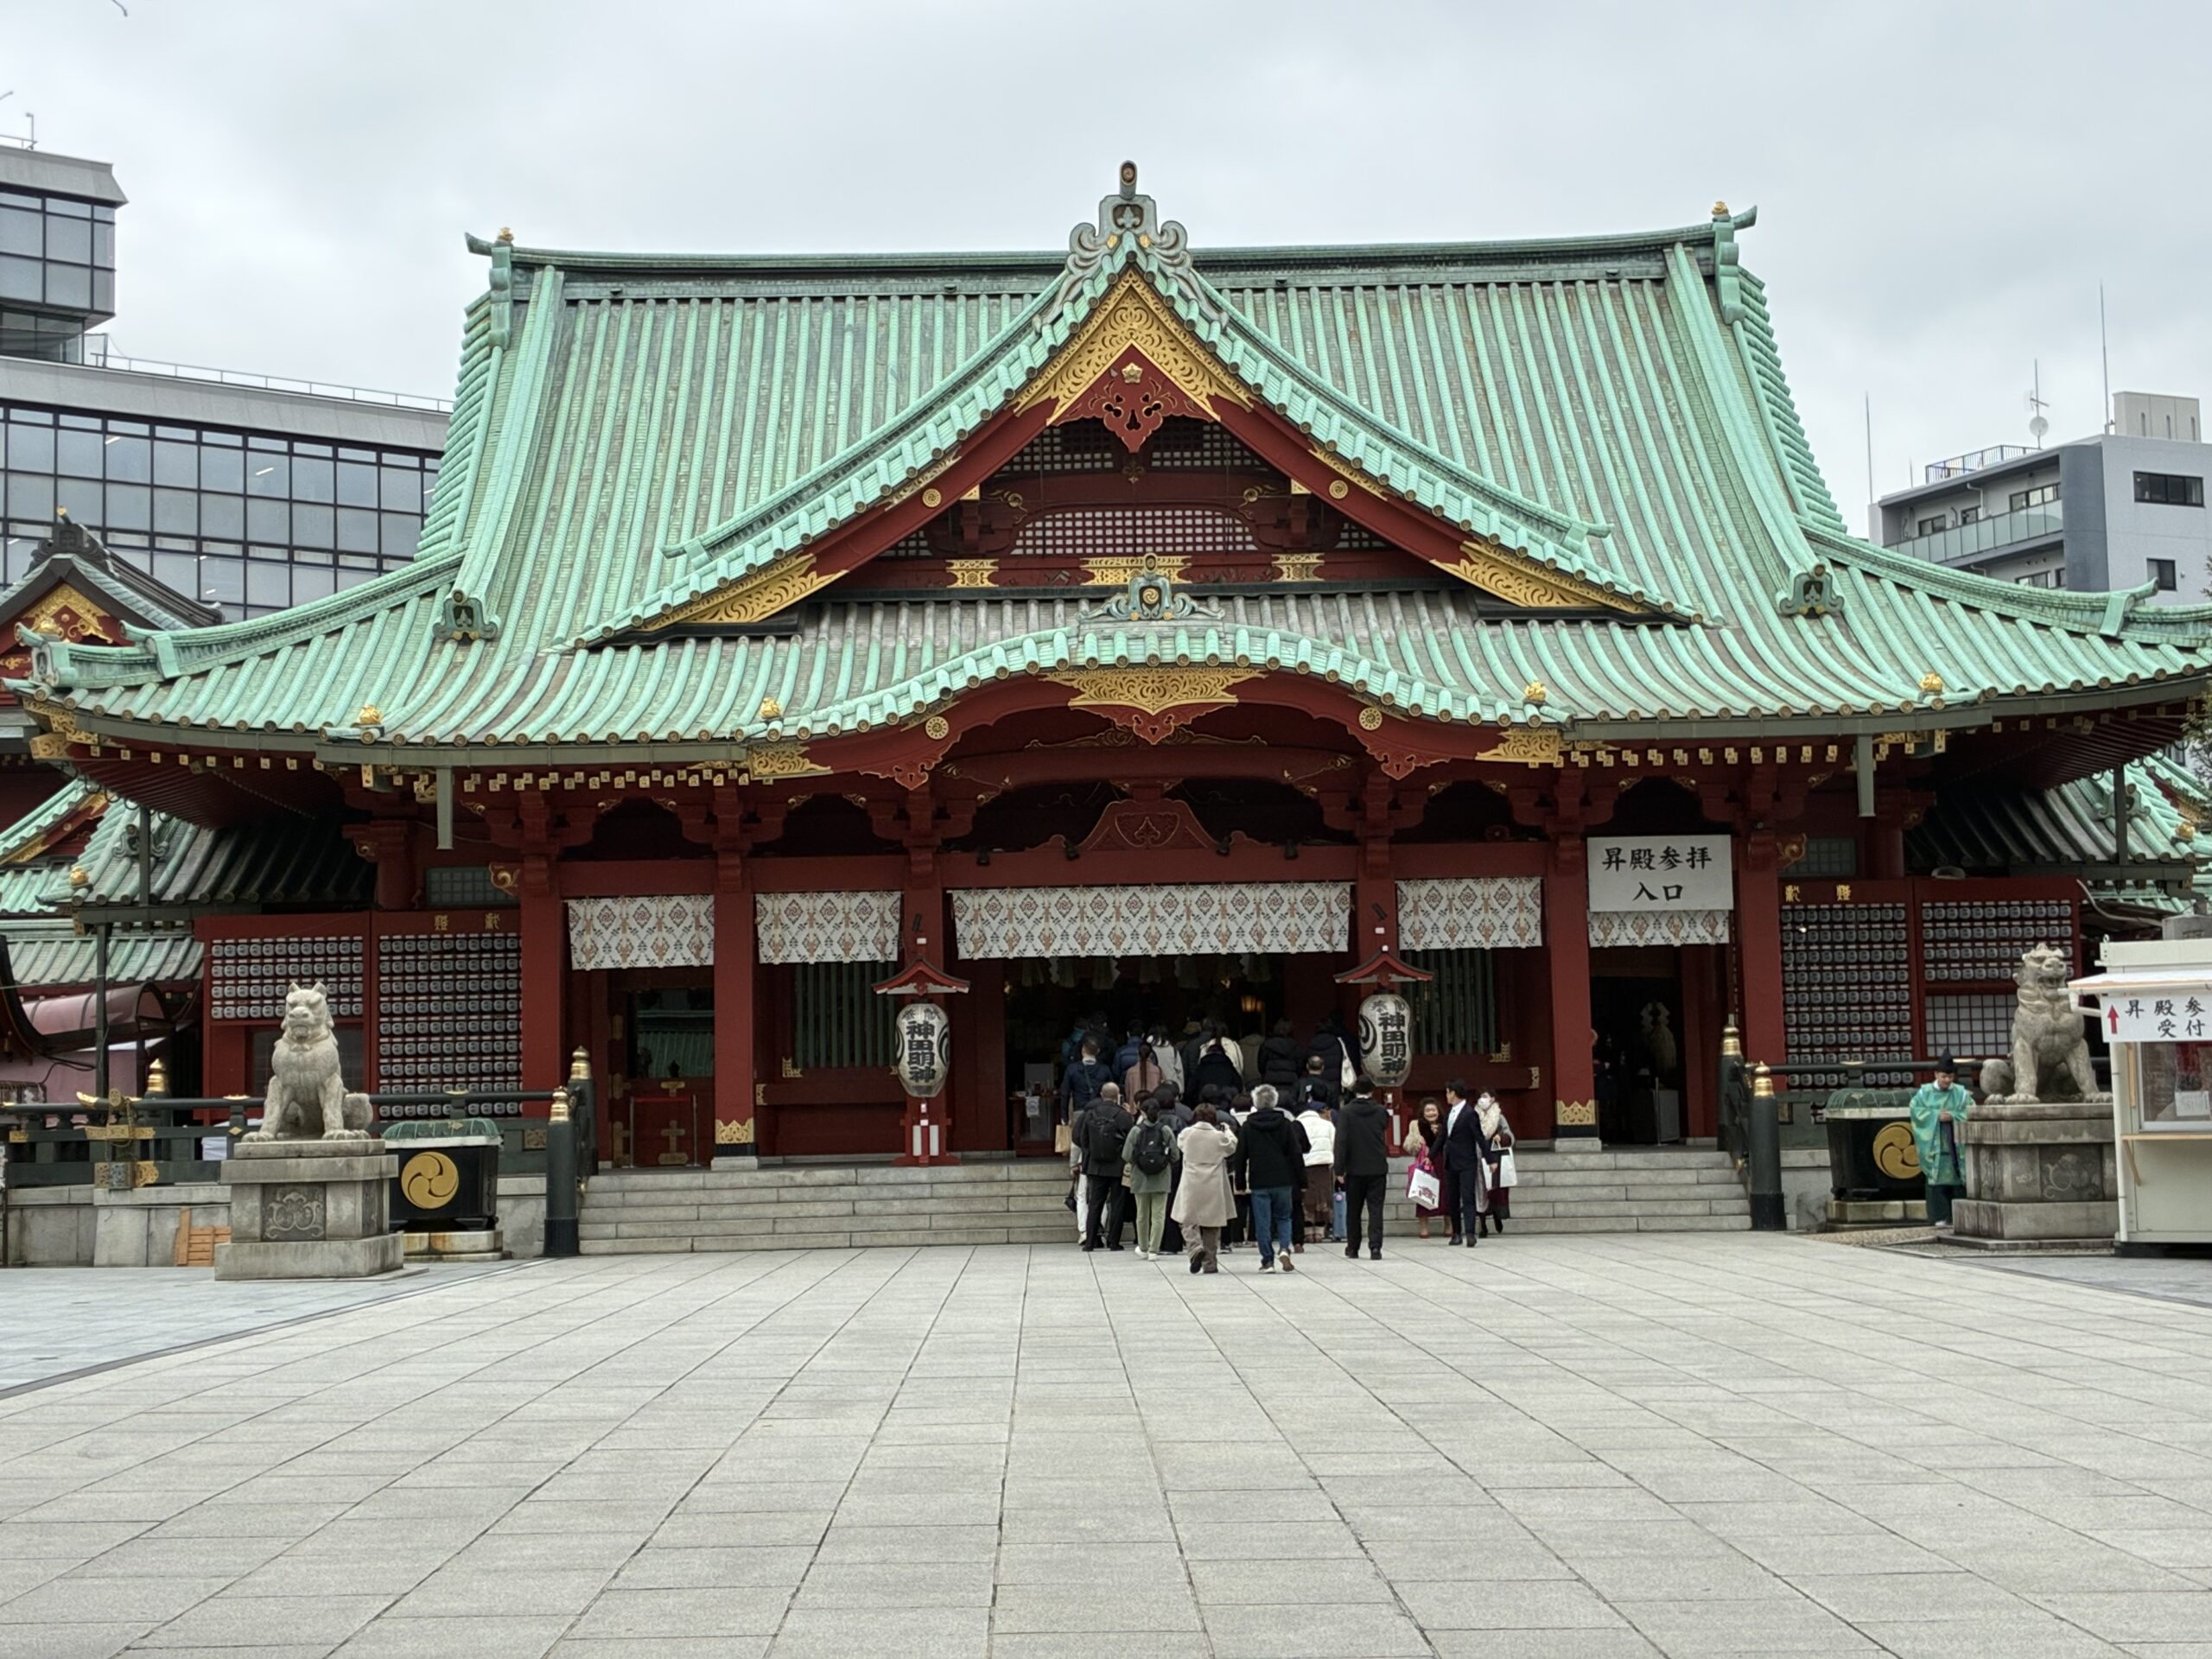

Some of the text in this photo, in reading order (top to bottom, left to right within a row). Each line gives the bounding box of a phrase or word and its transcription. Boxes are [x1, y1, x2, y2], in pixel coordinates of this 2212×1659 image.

[1602, 845, 1712, 872] 昇殿参拝
[1632, 881, 1683, 901] 入口
[2125, 996, 2205, 1019] 昇殿参
[2158, 1019, 2205, 1038] 受付
[906, 1020, 937, 1083] 神田明神
[1378, 1012, 1407, 1074] 神田明神
